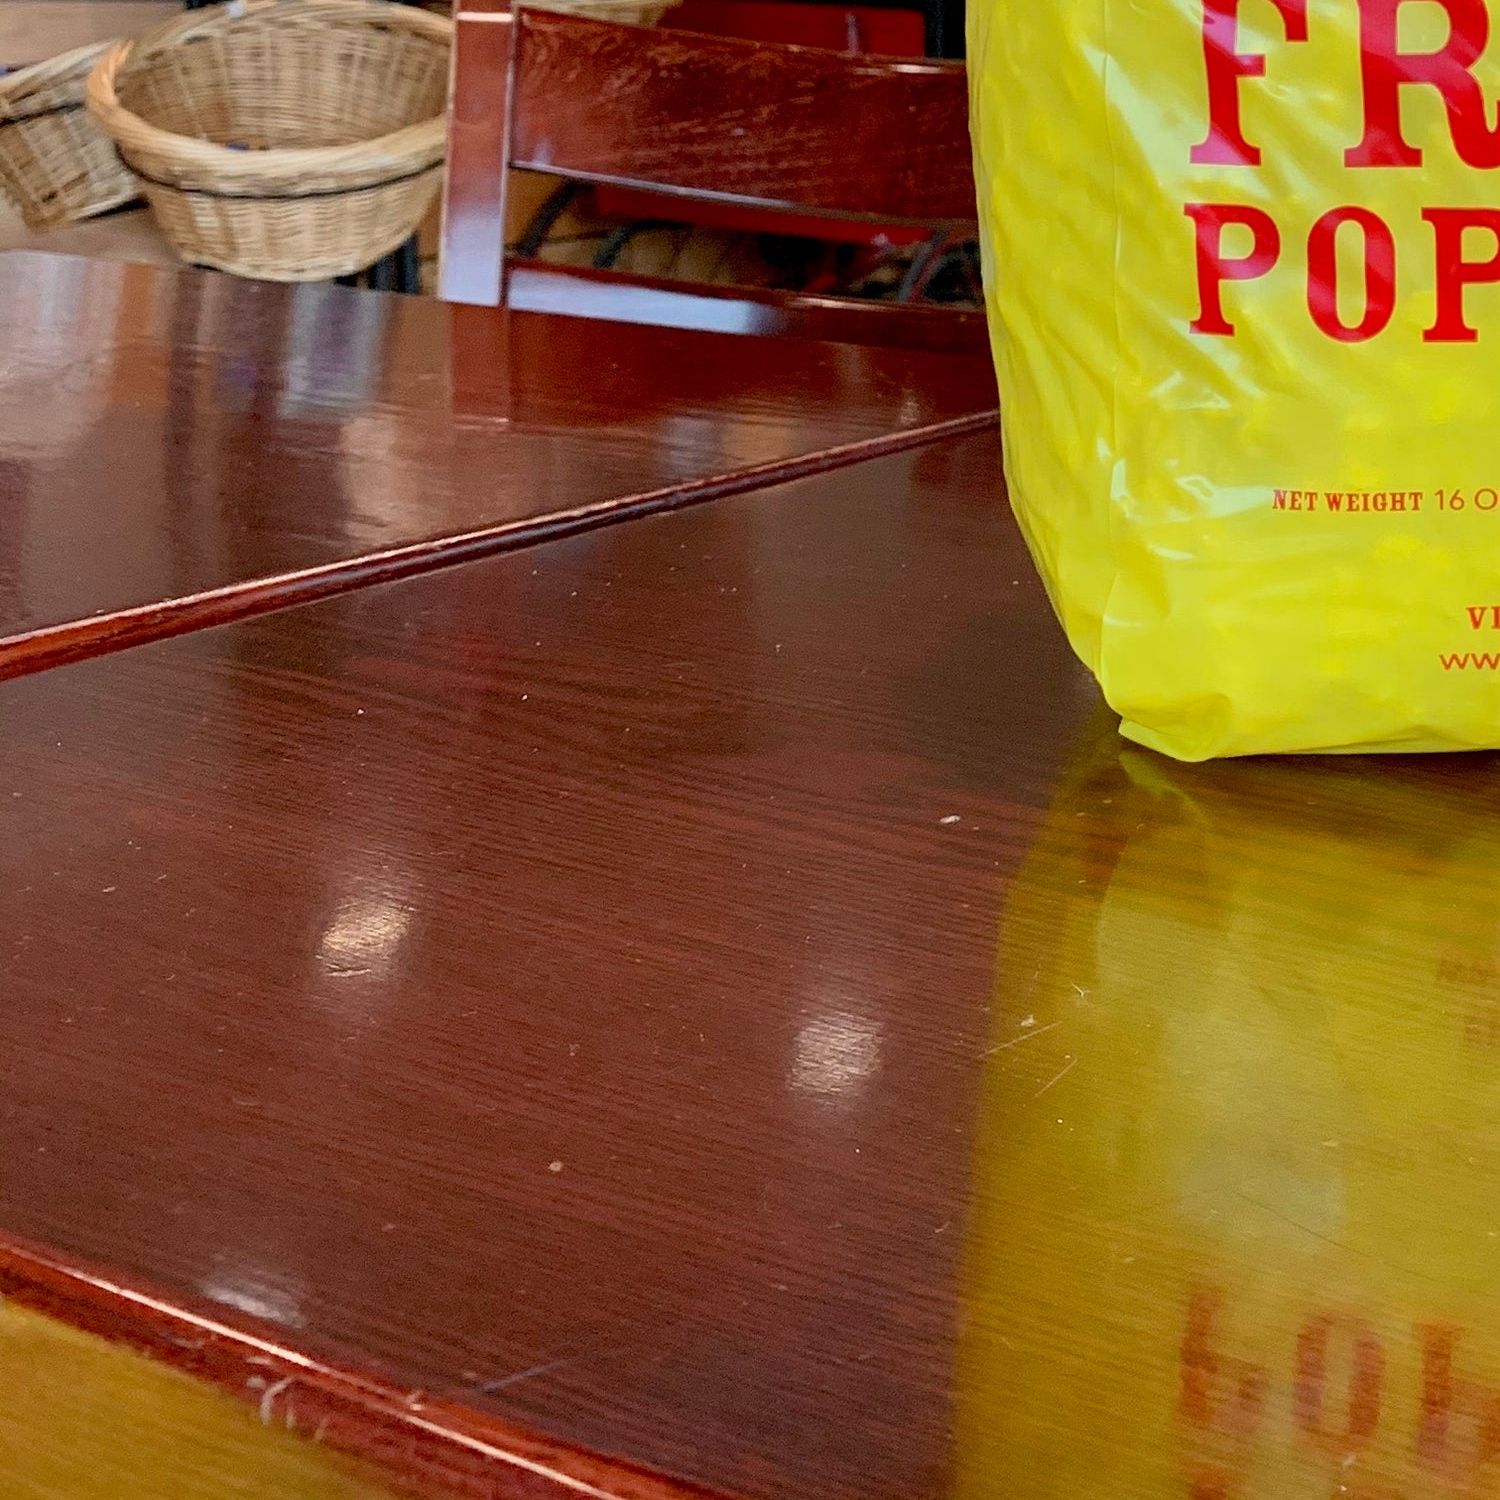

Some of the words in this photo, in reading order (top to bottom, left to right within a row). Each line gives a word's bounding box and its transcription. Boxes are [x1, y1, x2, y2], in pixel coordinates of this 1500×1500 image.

[1271, 488, 1318, 512] NET
[1323, 490, 1424, 513] WEIGHT
[1433, 488, 1466, 512] 16
